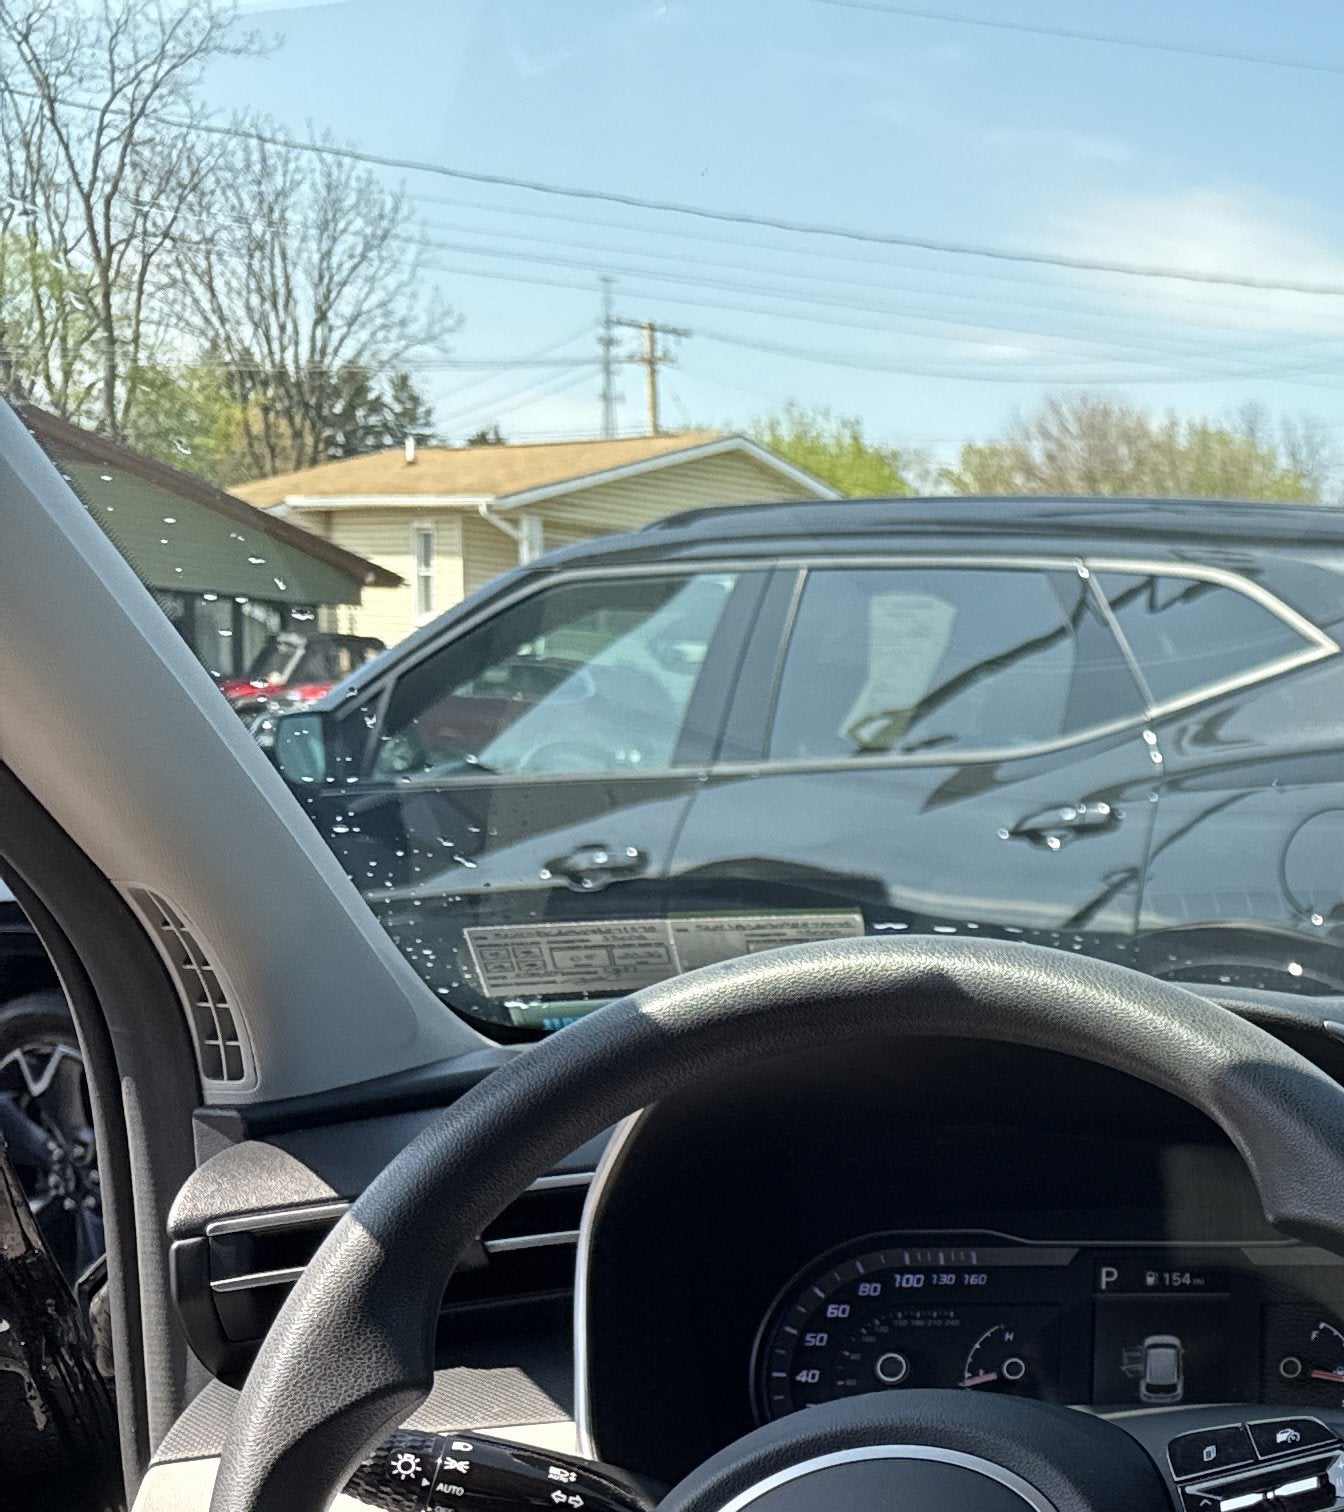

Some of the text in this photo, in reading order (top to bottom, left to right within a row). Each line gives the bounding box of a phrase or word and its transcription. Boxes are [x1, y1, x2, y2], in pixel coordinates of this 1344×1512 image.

[893, 1273, 925, 1288] 100
[930, 1274, 956, 1286] 130
[962, 1273, 988, 1286] 160
[1101, 1266, 1119, 1290] P
[1163, 1271, 1192, 1286] 154
[857, 1282, 882, 1297] 80
[826, 1303, 850, 1318] 60
[804, 1332, 828, 1347] 50
[795, 1369, 820, 1384] 40
[435, 1482, 465, 1497] AUTO
